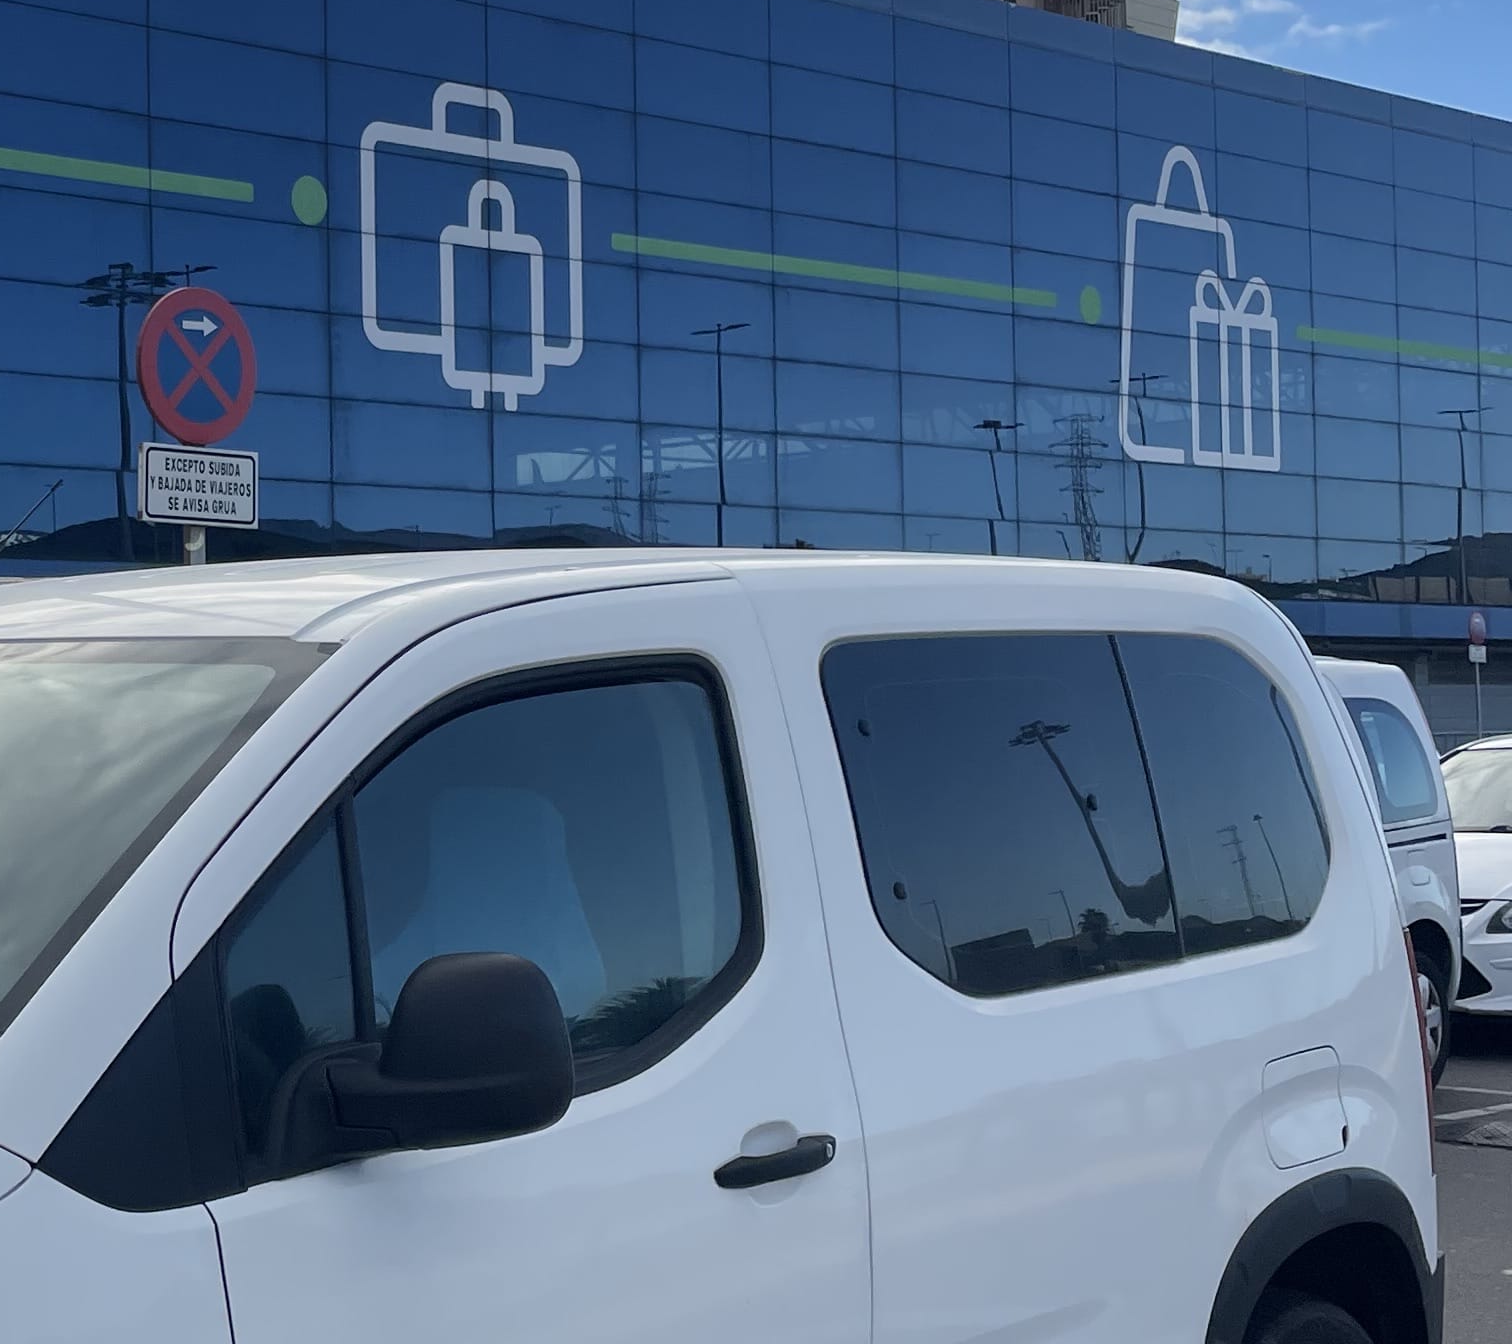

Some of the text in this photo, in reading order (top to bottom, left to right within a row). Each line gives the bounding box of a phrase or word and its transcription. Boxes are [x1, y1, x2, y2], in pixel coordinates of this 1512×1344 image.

[165, 457, 240, 477] EXCEPTO SUBIDA
[151, 476, 251, 497] Y BAJADA DE VIAJEROS
[168, 497, 236, 514] SE AVISA GRUA
